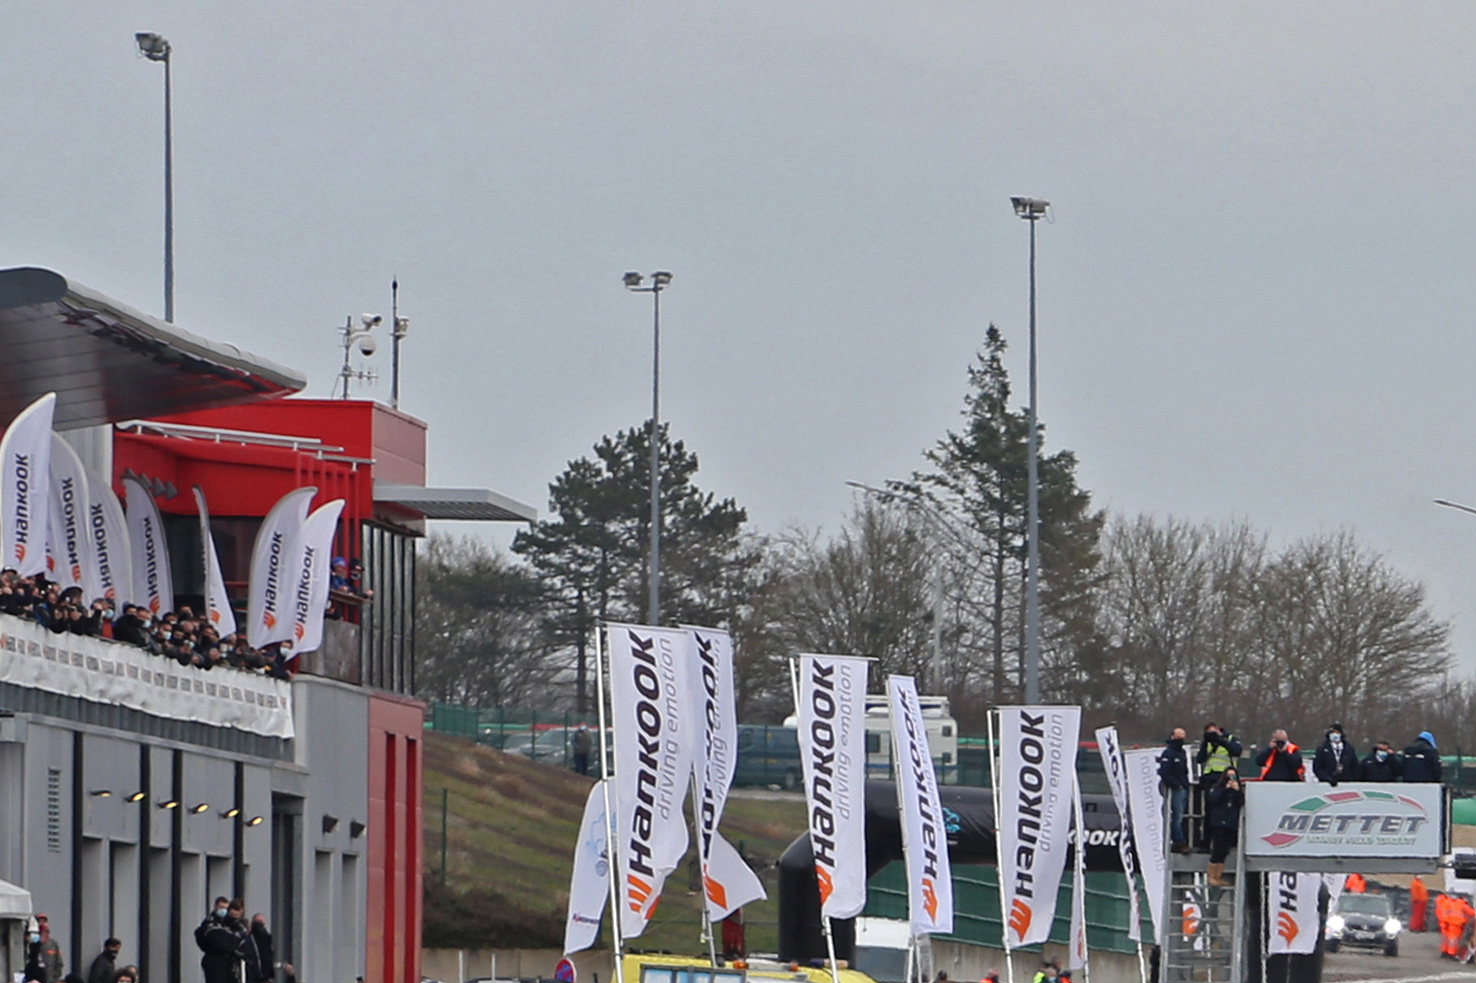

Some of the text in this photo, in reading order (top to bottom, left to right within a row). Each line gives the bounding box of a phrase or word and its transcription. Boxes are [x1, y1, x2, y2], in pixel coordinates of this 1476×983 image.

[660, 637, 680, 821] driving emotion
[834, 663, 852, 820] driving emotion
[1038, 713, 1064, 852] driving emotion
[1277, 814, 1428, 834] METTET
